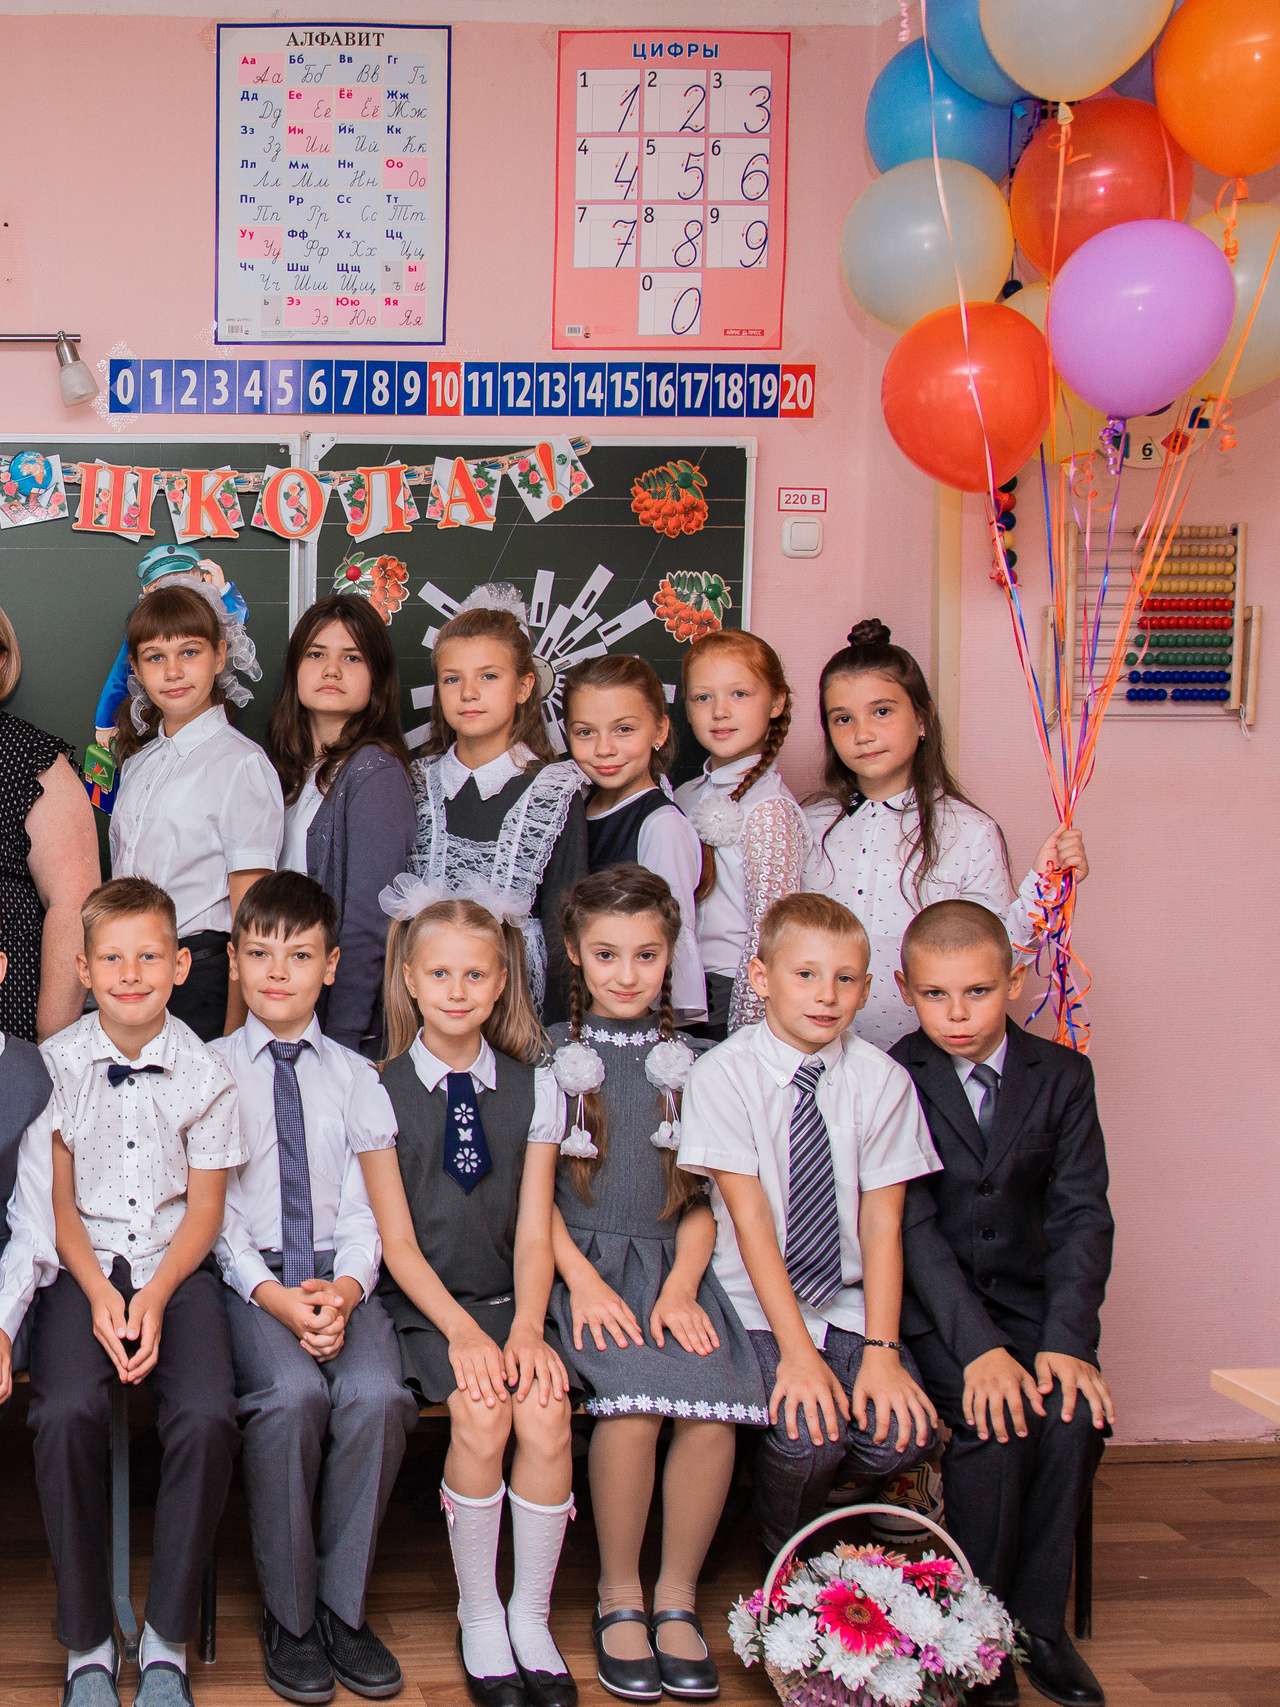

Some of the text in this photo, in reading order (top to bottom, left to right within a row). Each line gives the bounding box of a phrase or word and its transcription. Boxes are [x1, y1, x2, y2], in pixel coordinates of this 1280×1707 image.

[286, 32, 385, 47] АЛФАВИТ
[633, 42, 718, 60] ЦИФРЫ
[241, 54, 398, 65] Аа Бб Вв Гг
[580, 71, 722, 89] 1 2 3
[240, 88, 409, 102] Дд Ее Ёё Жж
[241, 125, 401, 135] Зз Ии Йй Кк
[578, 139, 721, 157] 4 5 6
[240, 159, 404, 169] Лл Мм Нн Оо
[240, 194, 399, 206] Пп Рр Сс Тт
[578, 207, 720, 224] 7 8 9
[240, 229, 403, 241] Уу Фф Хх Цц
[240, 262, 361, 274] Чч Шш Щщ
[642, 275, 653, 292] 0
[287, 296, 398, 307] Ээ Юю Яя
[116, 369, 813, 410] 0 1 2 3 4 5 6 7 8 9 10 11 12 13 14 15 16 17 18 19 20
[1142, 442, 1153, 459] 6
[75, 441, 567, 540] ШКОЛА!
[784, 493, 821, 505] 220 В
